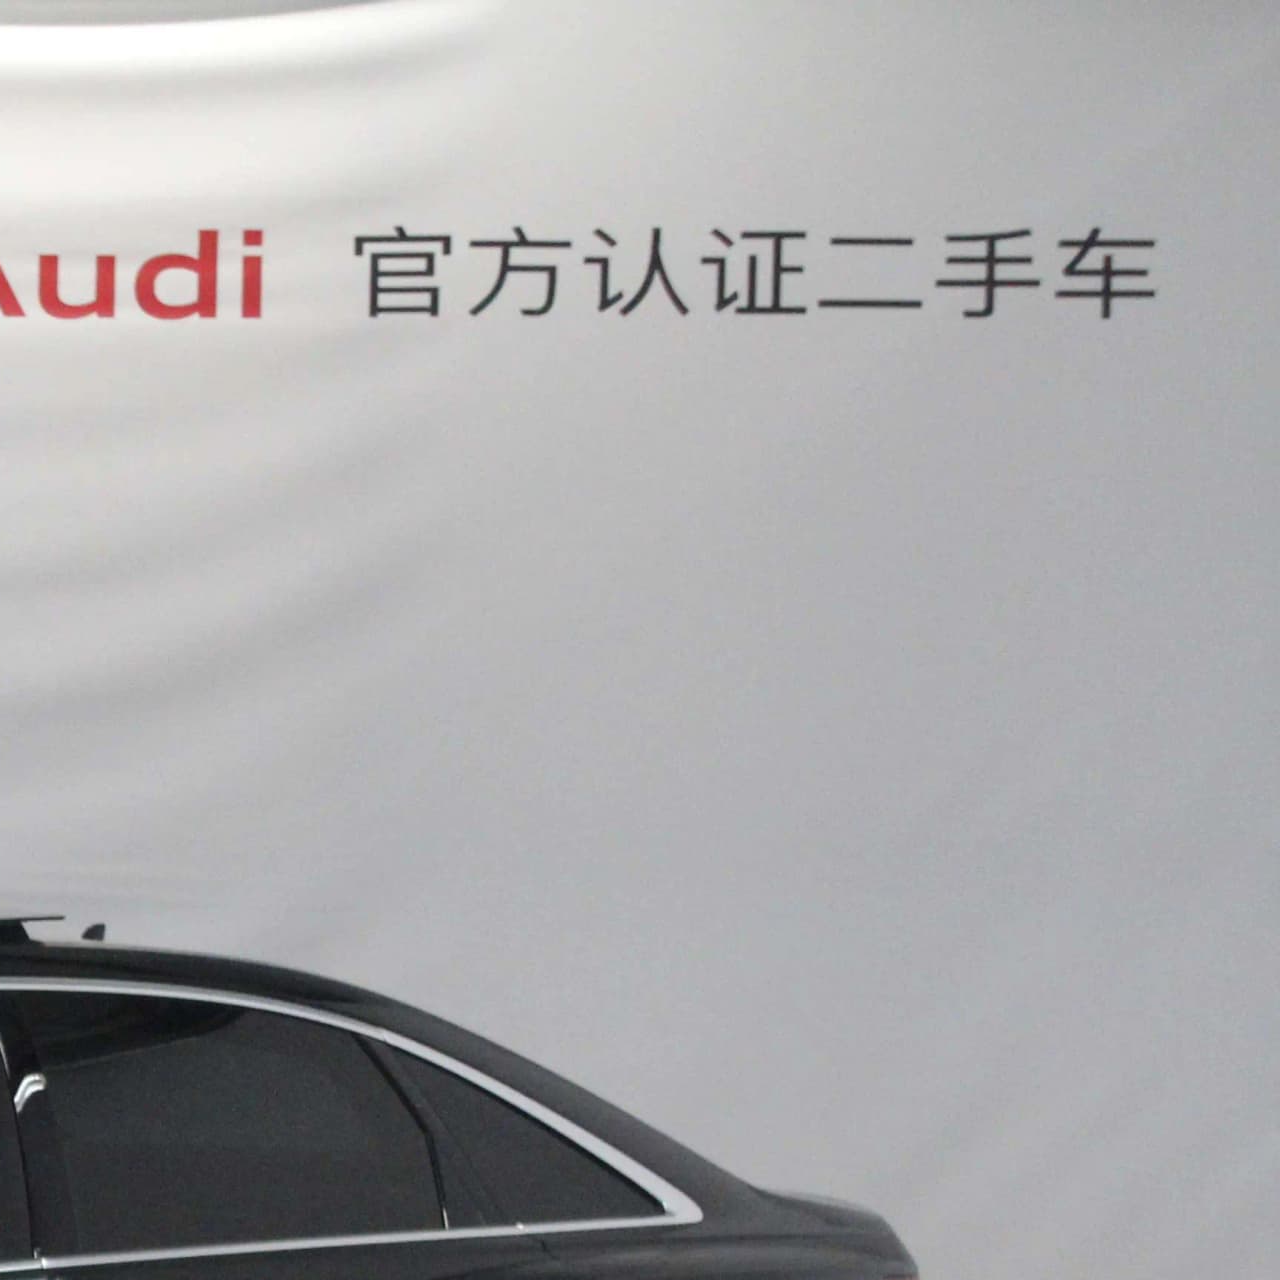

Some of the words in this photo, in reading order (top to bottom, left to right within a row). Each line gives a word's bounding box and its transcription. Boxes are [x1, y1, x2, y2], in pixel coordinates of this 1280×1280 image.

[354, 226, 1157, 320] 官方认证二手车
